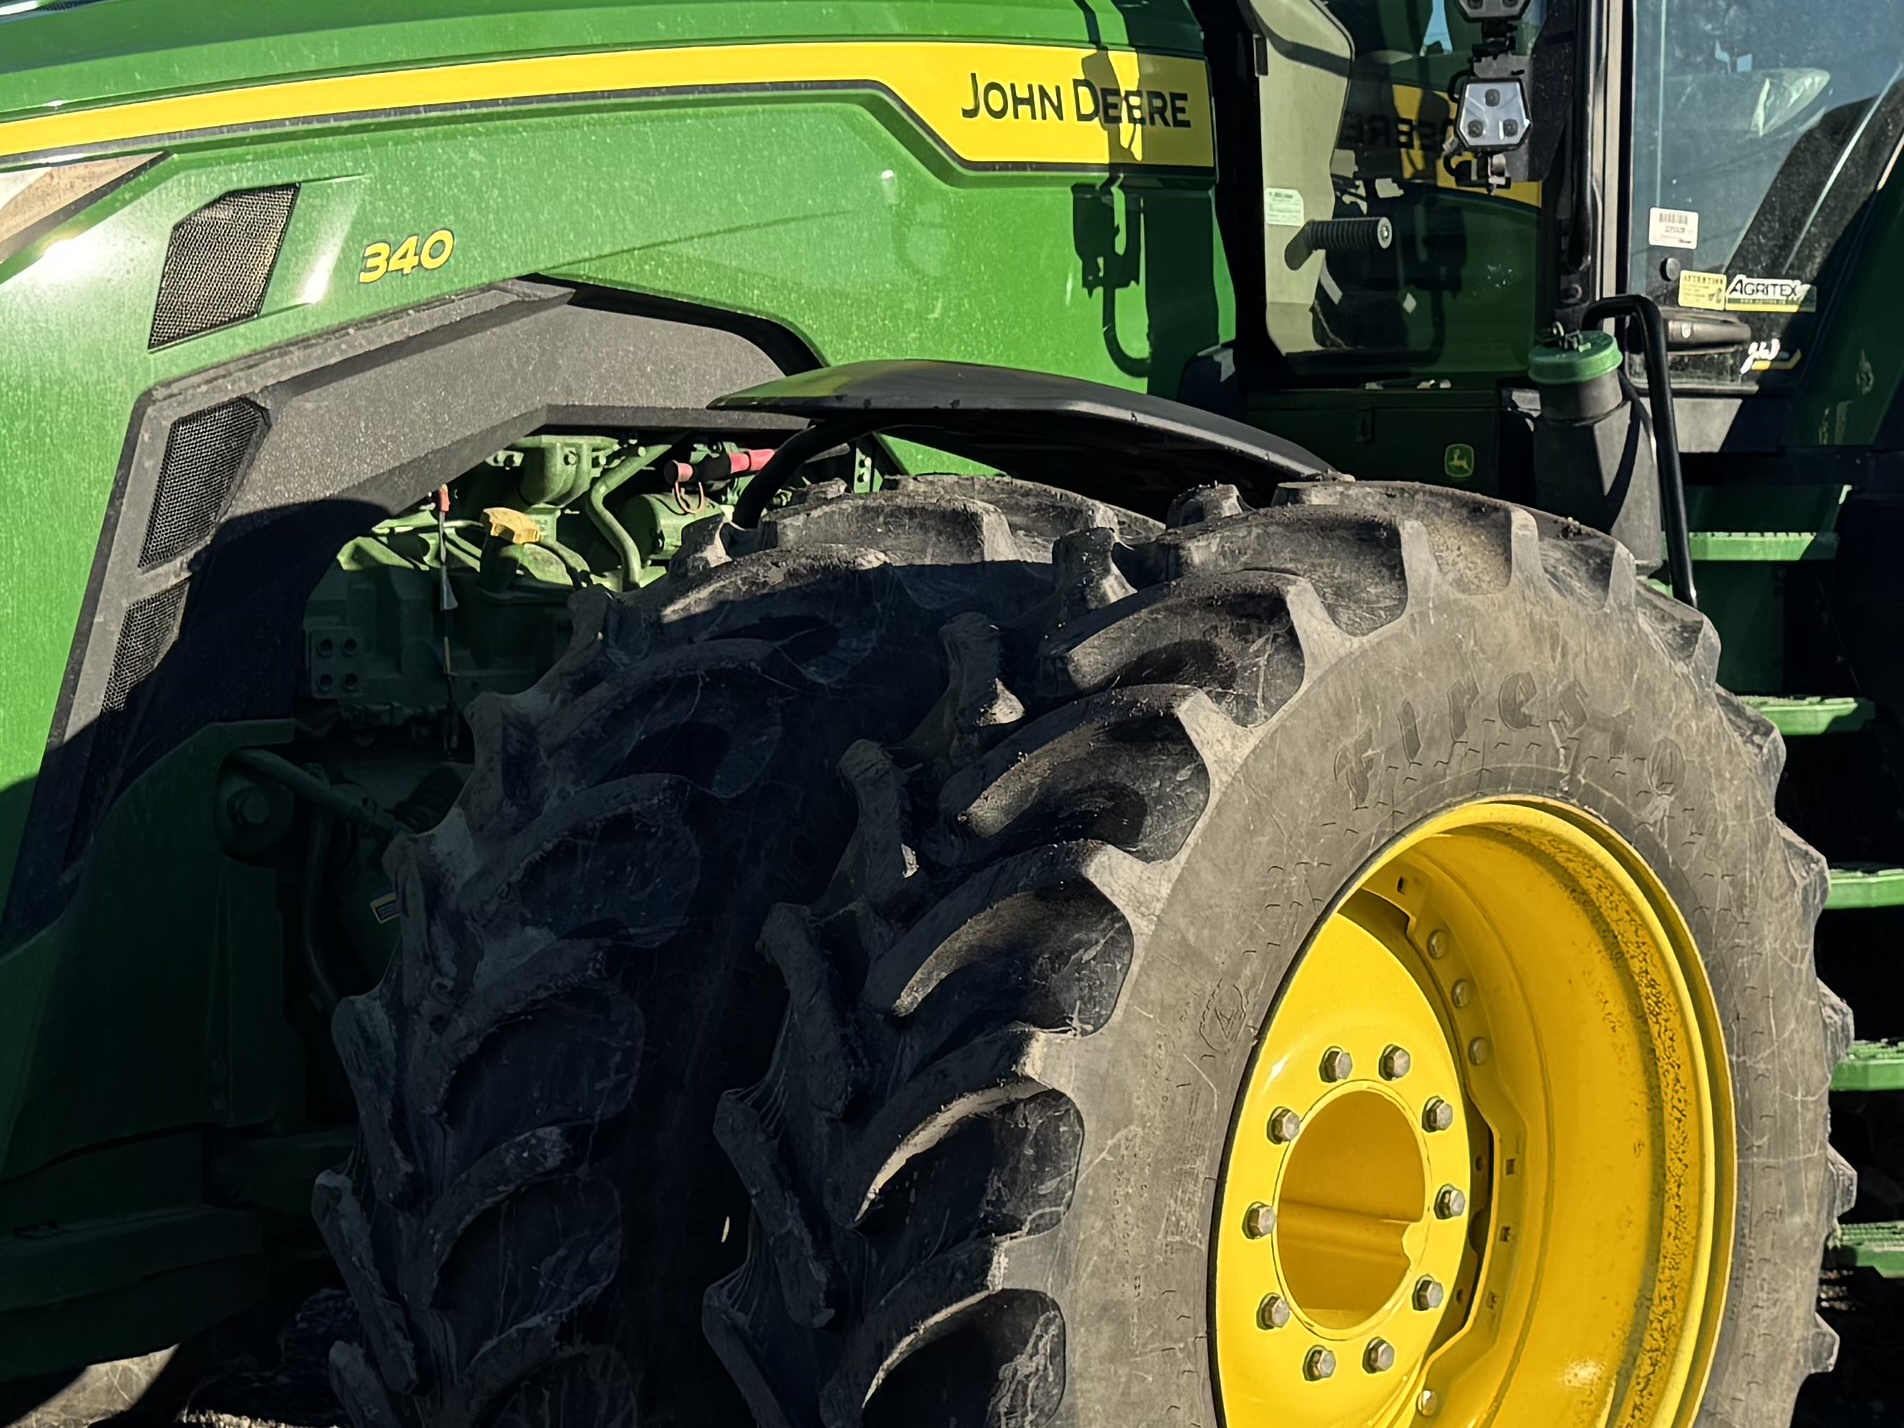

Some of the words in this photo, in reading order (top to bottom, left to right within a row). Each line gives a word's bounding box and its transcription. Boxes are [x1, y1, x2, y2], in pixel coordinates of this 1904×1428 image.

[962, 72, 1063, 121] JOHN
[1072, 79, 1192, 128] DEERE
[359, 229, 454, 283] 340
[1729, 279, 1798, 297] AGRITEX
